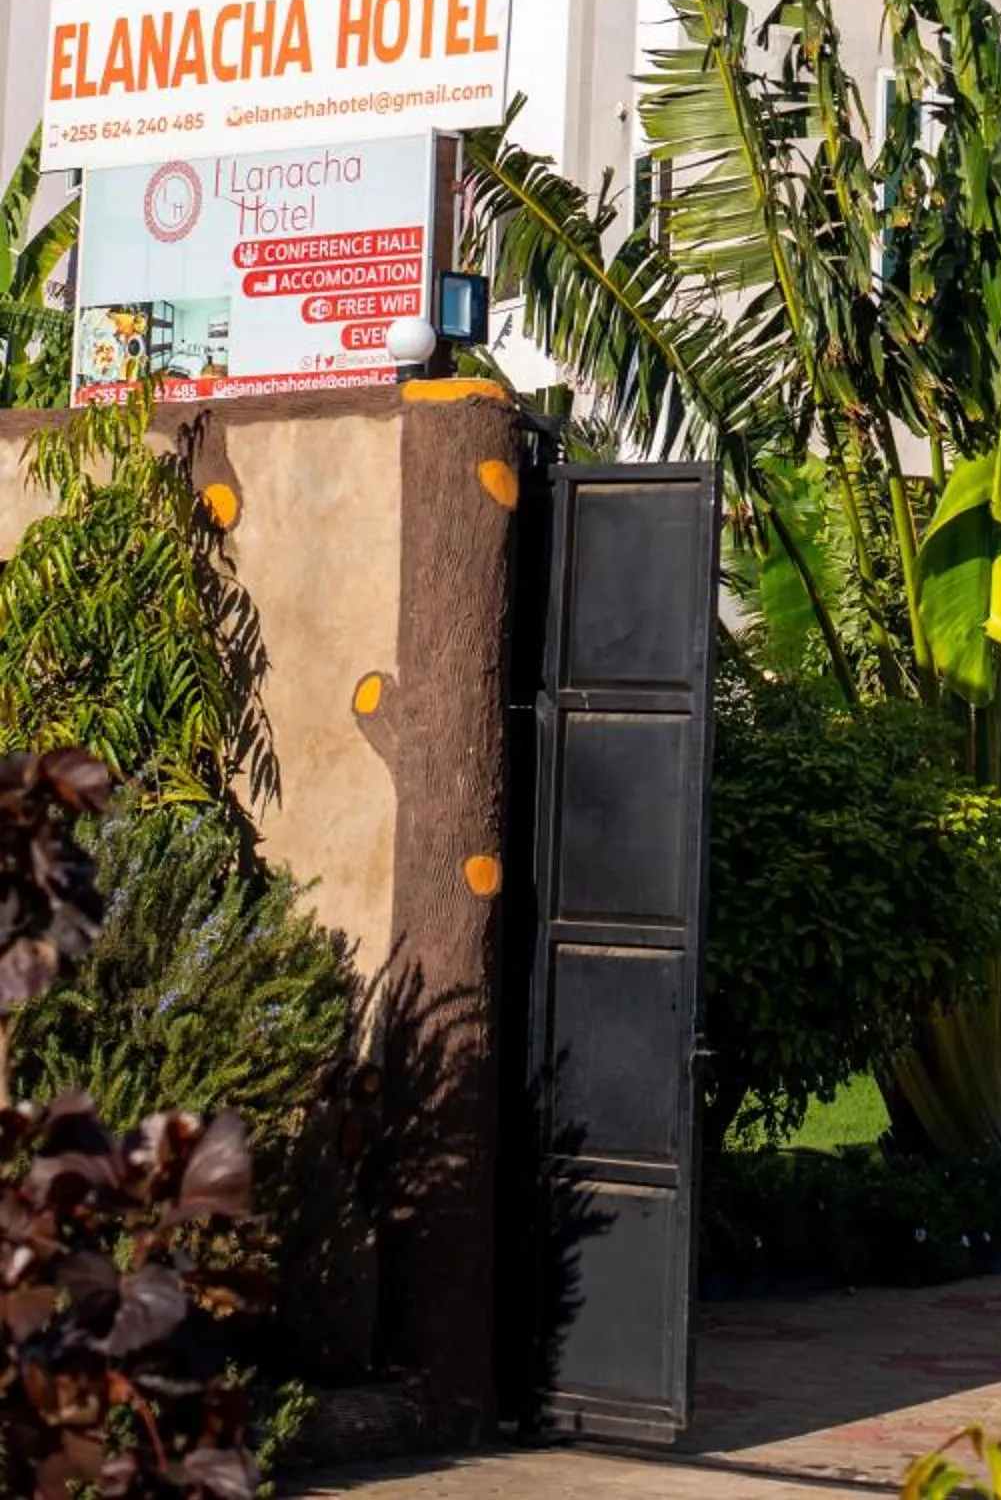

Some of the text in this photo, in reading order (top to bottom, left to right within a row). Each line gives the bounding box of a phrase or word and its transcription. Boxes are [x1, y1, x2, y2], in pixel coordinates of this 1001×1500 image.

[61, 82, 493, 143] +255 624 240 485 elanachahotel@gmail.com
[239, 195, 315, 235] Hotel
[264, 233, 420, 262] CONFERENCE HALL
[279, 262, 417, 291] ACCOMODATION
[337, 296, 376, 316] FREE
[381, 293, 416, 313] WIFI
[172, 382, 197, 399] 485
[226, 371, 397, 397] elanachahotel@gmail.co
